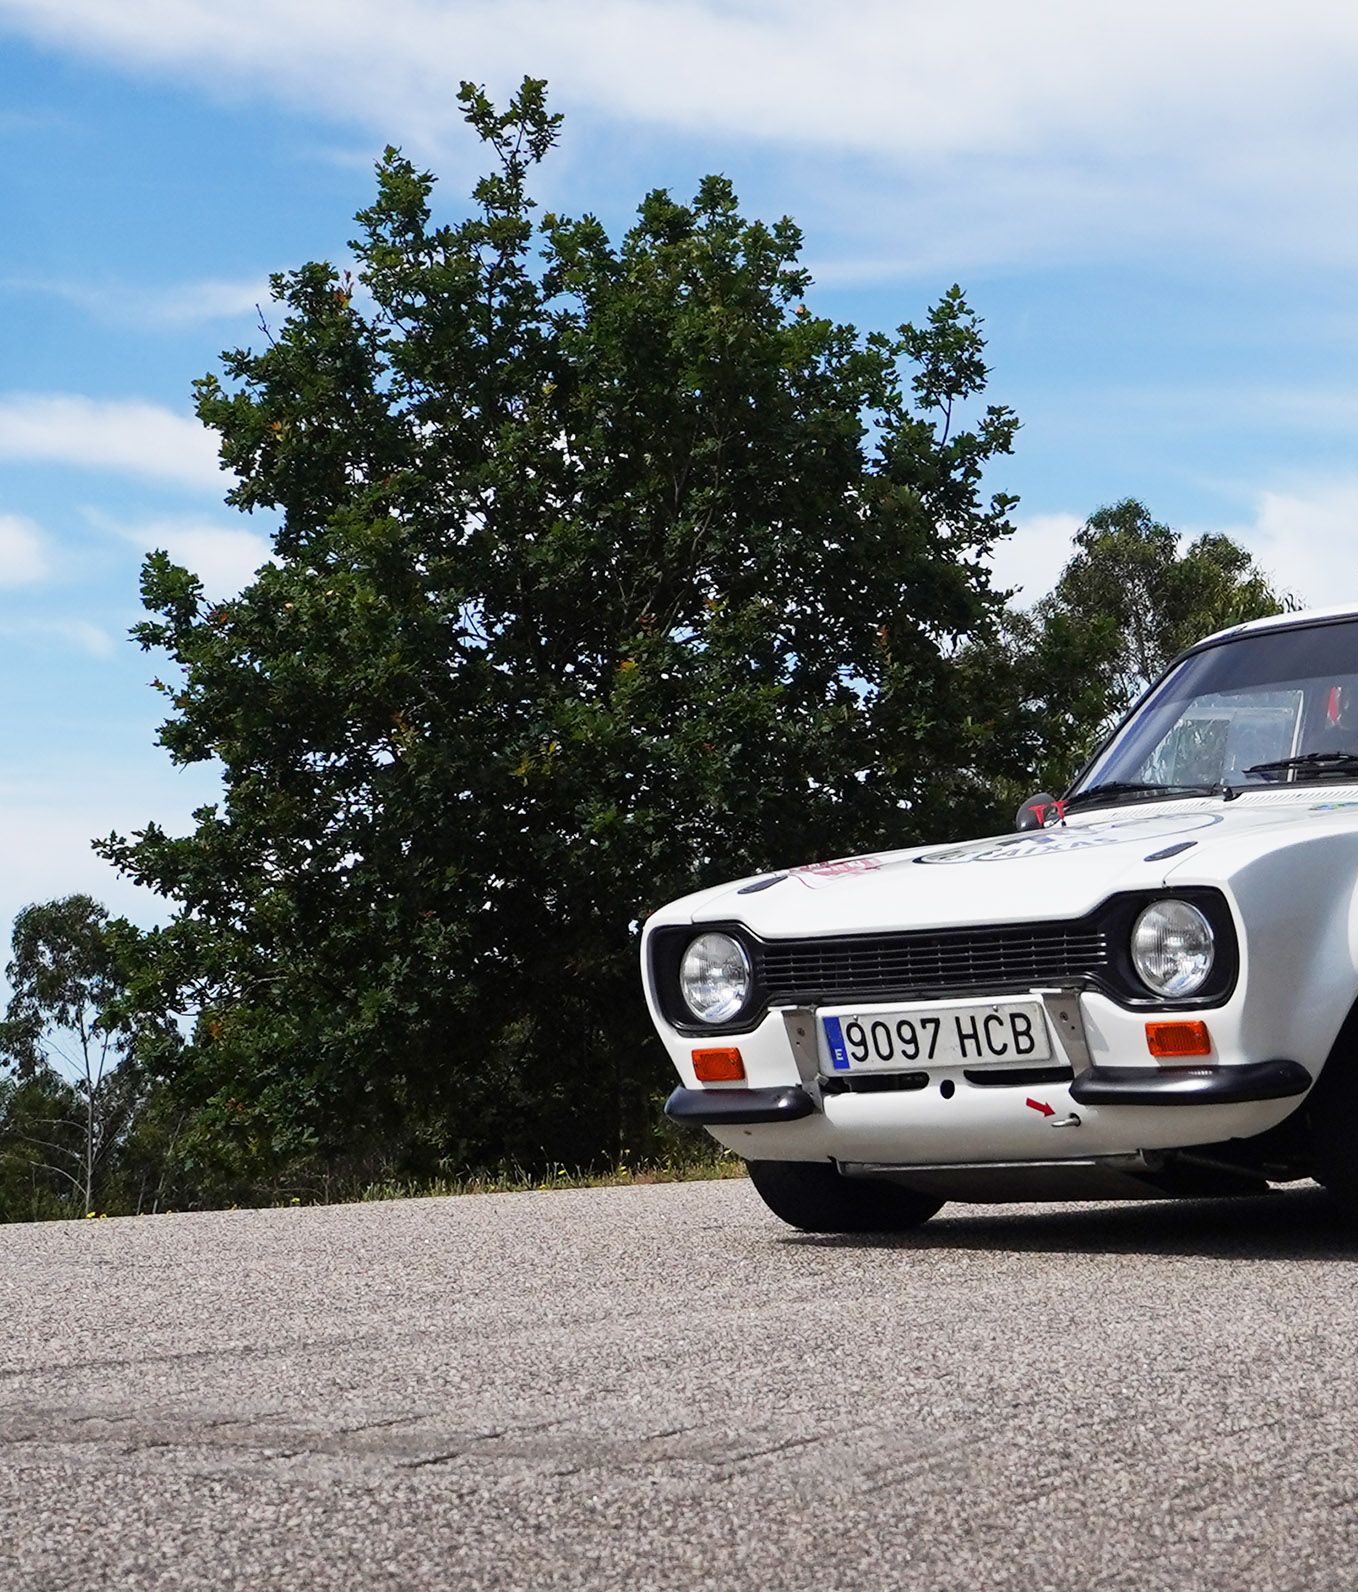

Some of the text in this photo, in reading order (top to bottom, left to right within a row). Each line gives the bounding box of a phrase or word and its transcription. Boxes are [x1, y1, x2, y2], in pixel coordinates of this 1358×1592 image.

[846, 1012, 1036, 1062] 9097 HCB
[835, 1048, 844, 1061] E
